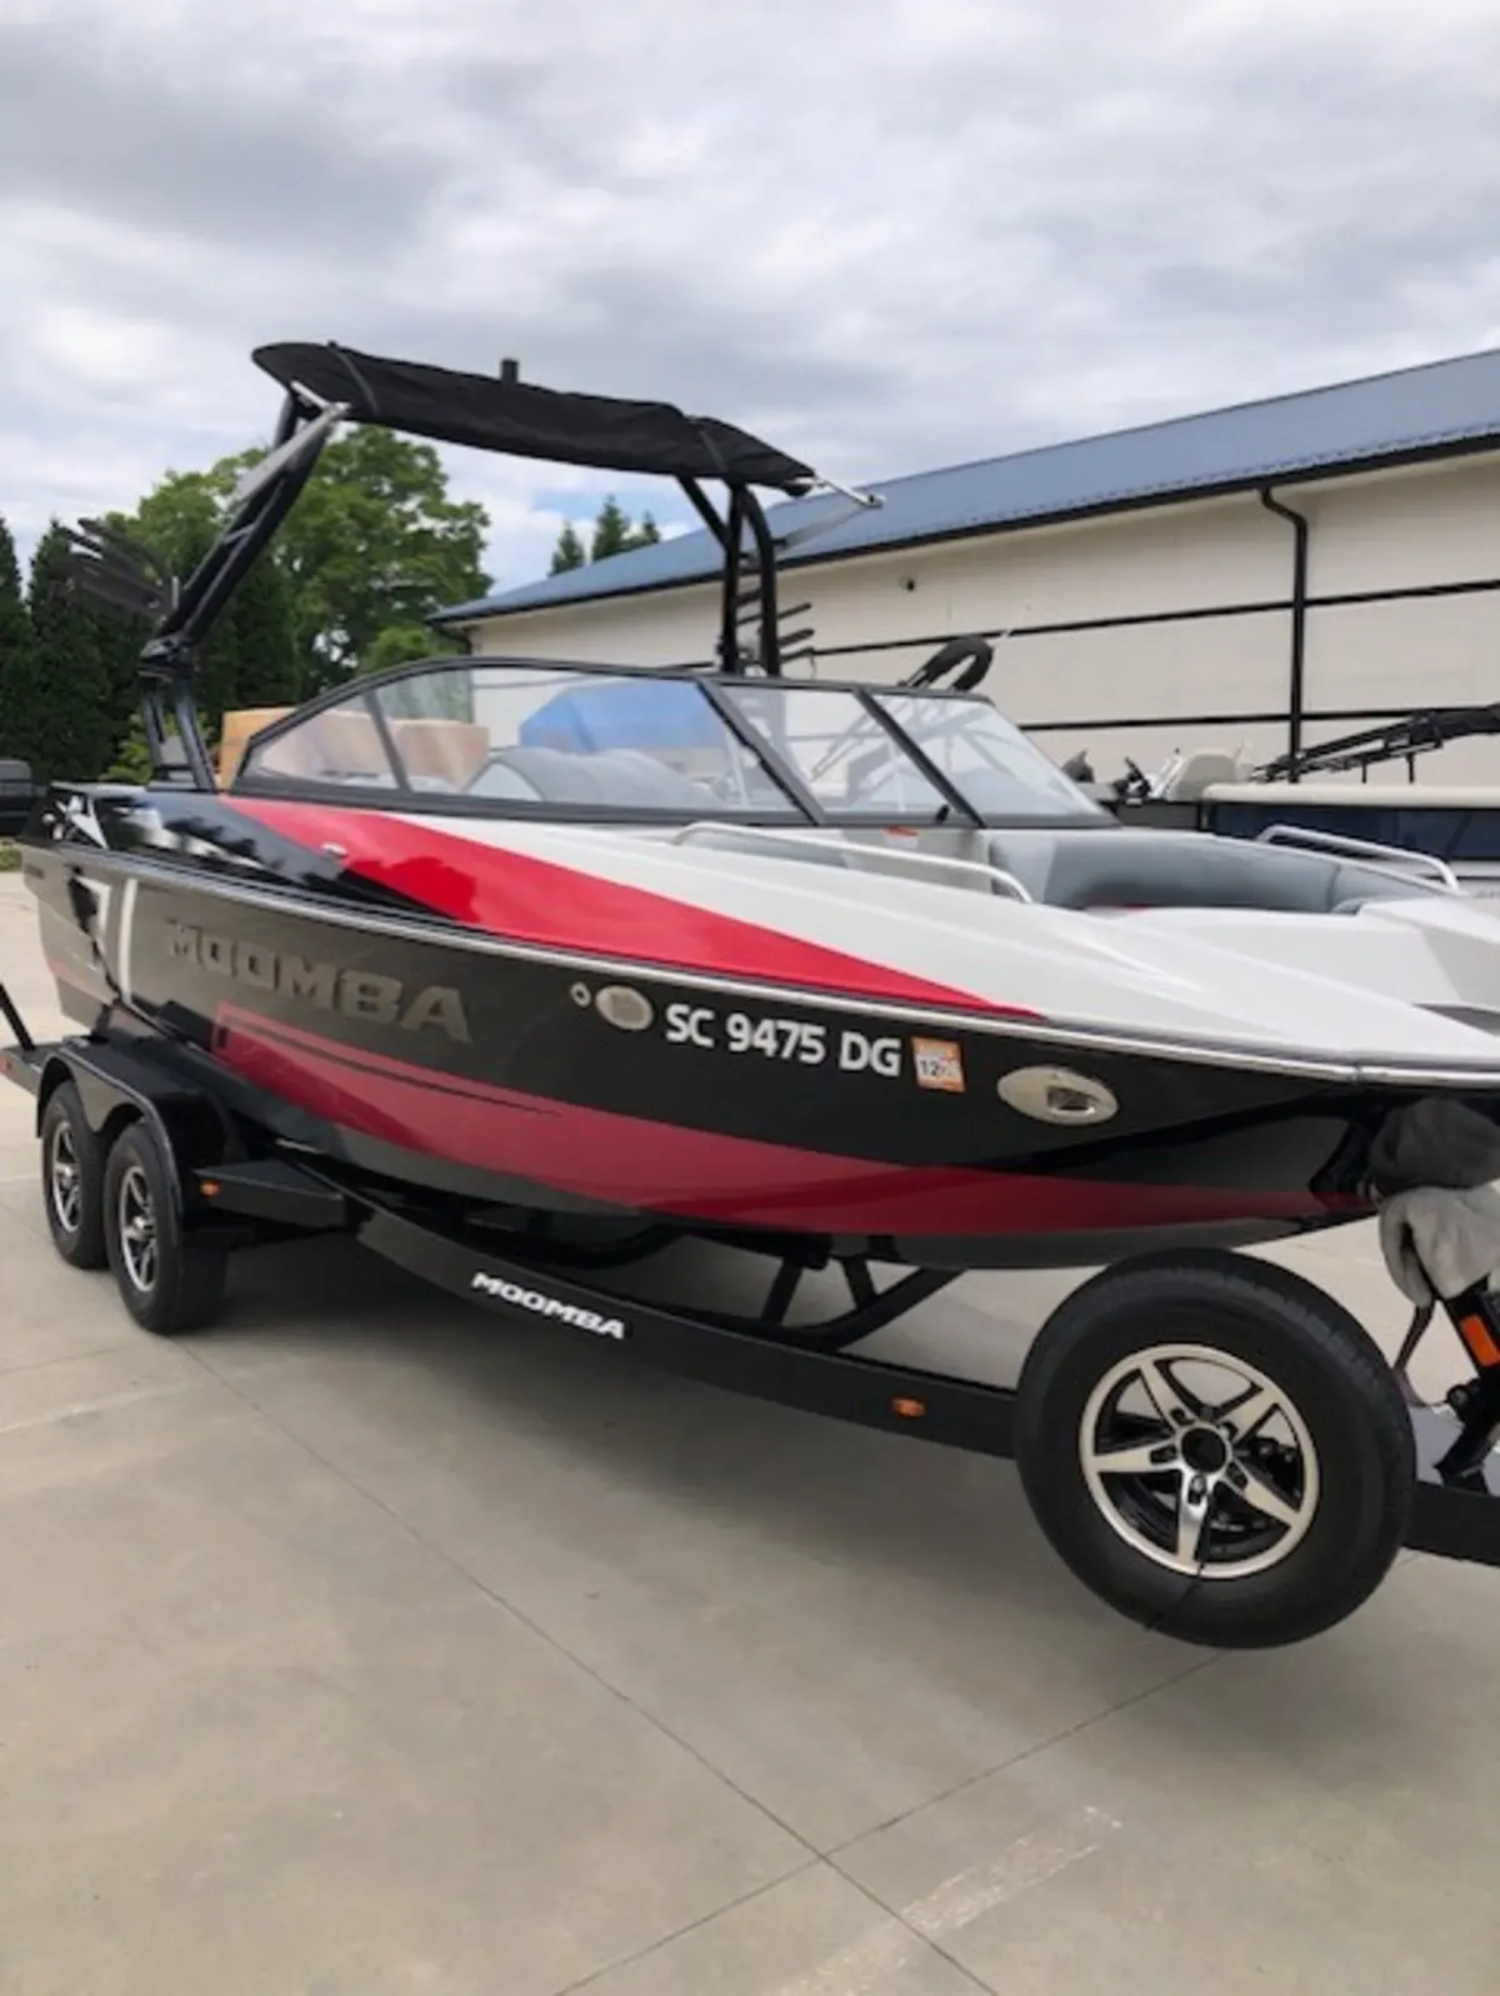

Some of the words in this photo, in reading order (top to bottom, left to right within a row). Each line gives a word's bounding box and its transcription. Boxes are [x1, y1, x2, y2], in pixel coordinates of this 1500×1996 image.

[168, 921, 473, 1043] MOOMBA
[665, 1003, 715, 1048] SC
[725, 1012, 827, 1065] 9475
[839, 1030, 902, 1077] DG
[471, 1271, 625, 1341] MOOMBA
